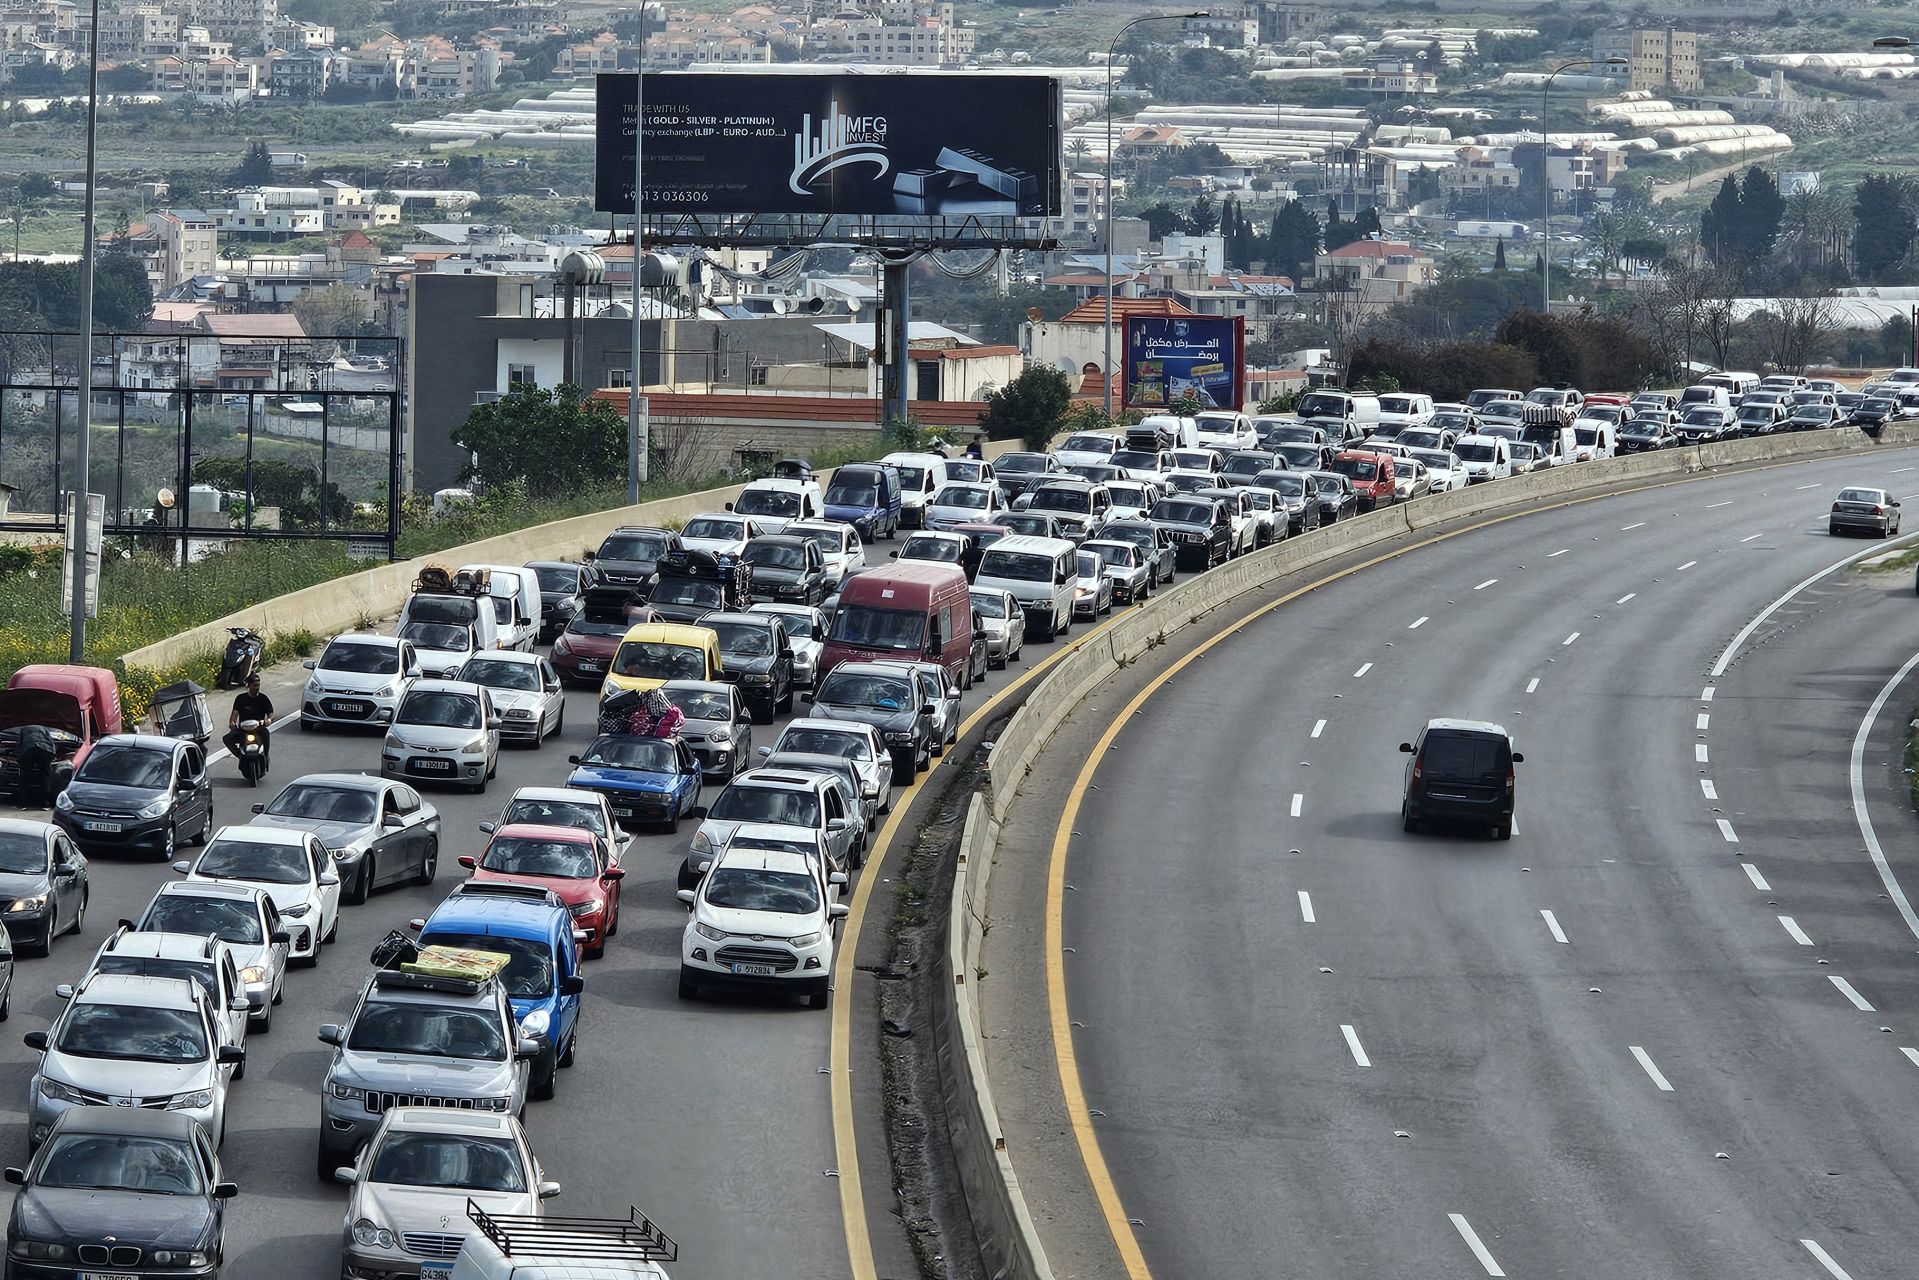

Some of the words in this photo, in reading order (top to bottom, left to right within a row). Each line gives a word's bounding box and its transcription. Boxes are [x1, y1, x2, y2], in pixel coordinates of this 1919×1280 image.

[653, 105, 676, 113] WITH
[678, 105, 690, 113] US
[686, 116, 717, 125] SILVER
[847, 116, 887, 133] MFG
[656, 128, 693, 138] exchange
[723, 128, 748, 137] EURO
[847, 132, 887, 142] INVEST
[652, 191, 659, 201] 3
[662, 191, 709, 202] 036306
